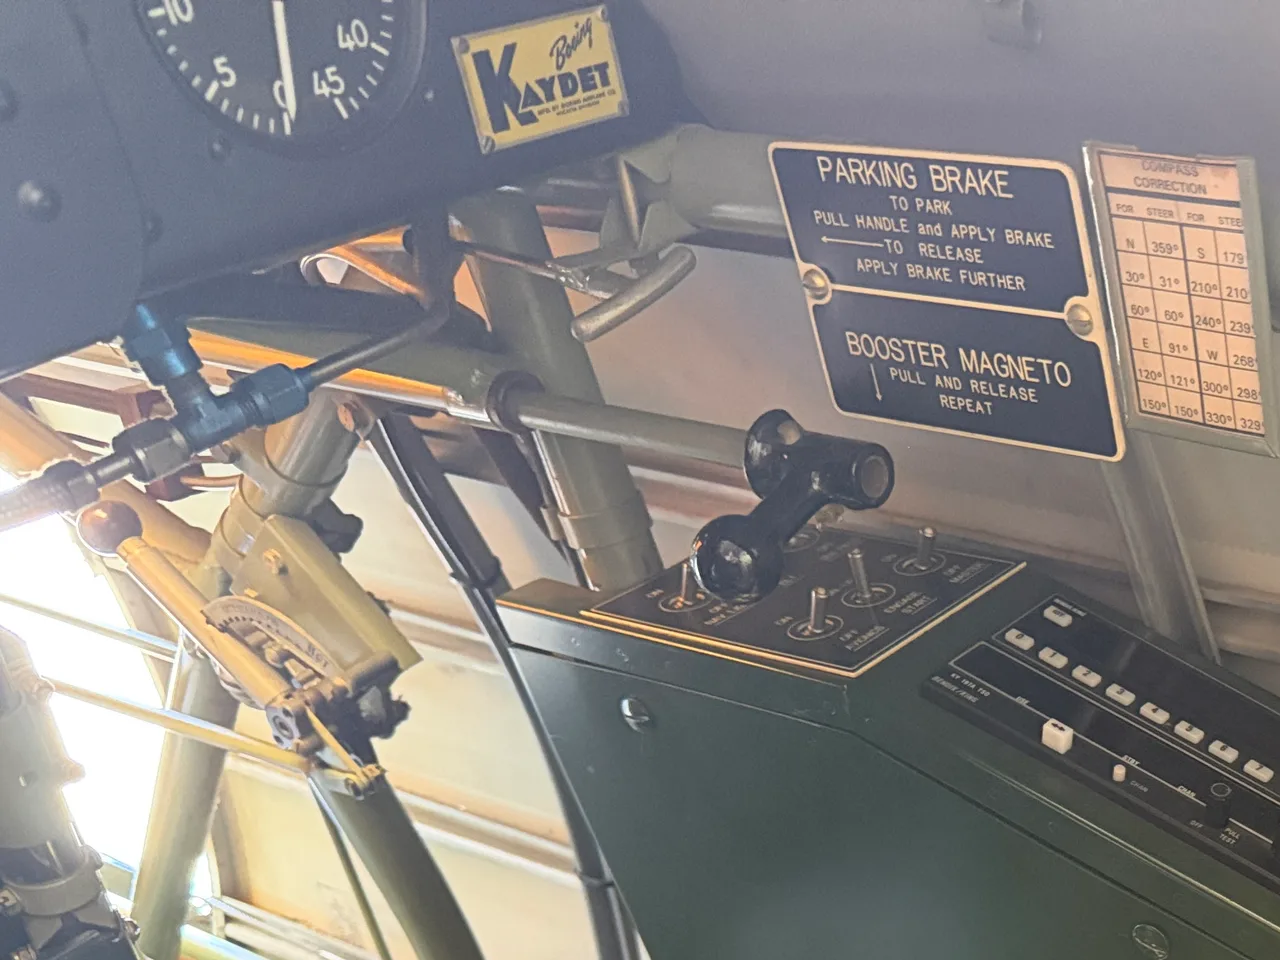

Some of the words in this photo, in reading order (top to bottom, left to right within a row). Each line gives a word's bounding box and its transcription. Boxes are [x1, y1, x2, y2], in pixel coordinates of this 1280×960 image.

[337, 19, 368, 49] 40
[549, 17, 593, 71] Boeing
[213, 56, 236, 87] 5
[312, 65, 345, 97] 45
[472, 42, 611, 134] KAYDET
[816, 155, 917, 190] PARKING
[928, 164, 1014, 199] BRAKE
[1140, 159, 1199, 177] COMPASS
[1134, 176, 1207, 195] CORRECTION
[889, 195, 909, 211] TO
[916, 197, 952, 215] PARK
[1116, 204, 1134, 214] FOR
[1146, 207, 1174, 218] STEER
[1186, 212, 1205, 222] FOR
[1218, 216, 1243, 227] STEE
[813, 210, 849, 227] PULL
[855, 214, 910, 233] HANDLE
[917, 221, 942, 237] and
[951, 224, 996, 243] APPLY
[1004, 229, 1055, 249] BRAKE
[884, 238, 903, 254] TO
[919, 243, 984, 264] RELEASE
[1126, 238, 1135, 249] N
[1197, 248, 1206, 259] S
[856, 258, 899, 275] APPLY
[906, 263, 952, 283] BRAKE
[959, 269, 1026, 291] FURTHER
[1230, 320, 1254, 334] 239
[845, 331, 949, 369] BOOSTER
[958, 347, 1072, 387] MAGNETO
[1142, 338, 1149, 349] E
[1206, 350, 1218, 361] W
[1233, 354, 1257, 367] 268
[889, 367, 926, 386] PULL
[935, 374, 962, 391] AND
[970, 379, 1039, 403] RELEASE
[1237, 386, 1260, 400] 298
[939, 394, 992, 415] REPEAT
[1240, 417, 1265, 431] 329
[1129, 780, 1149, 793] CHAN
[1177, 785, 1196, 798] CHAN
[1220, 833, 1237, 845] TEST
[1224, 827, 1241, 839] PULL
